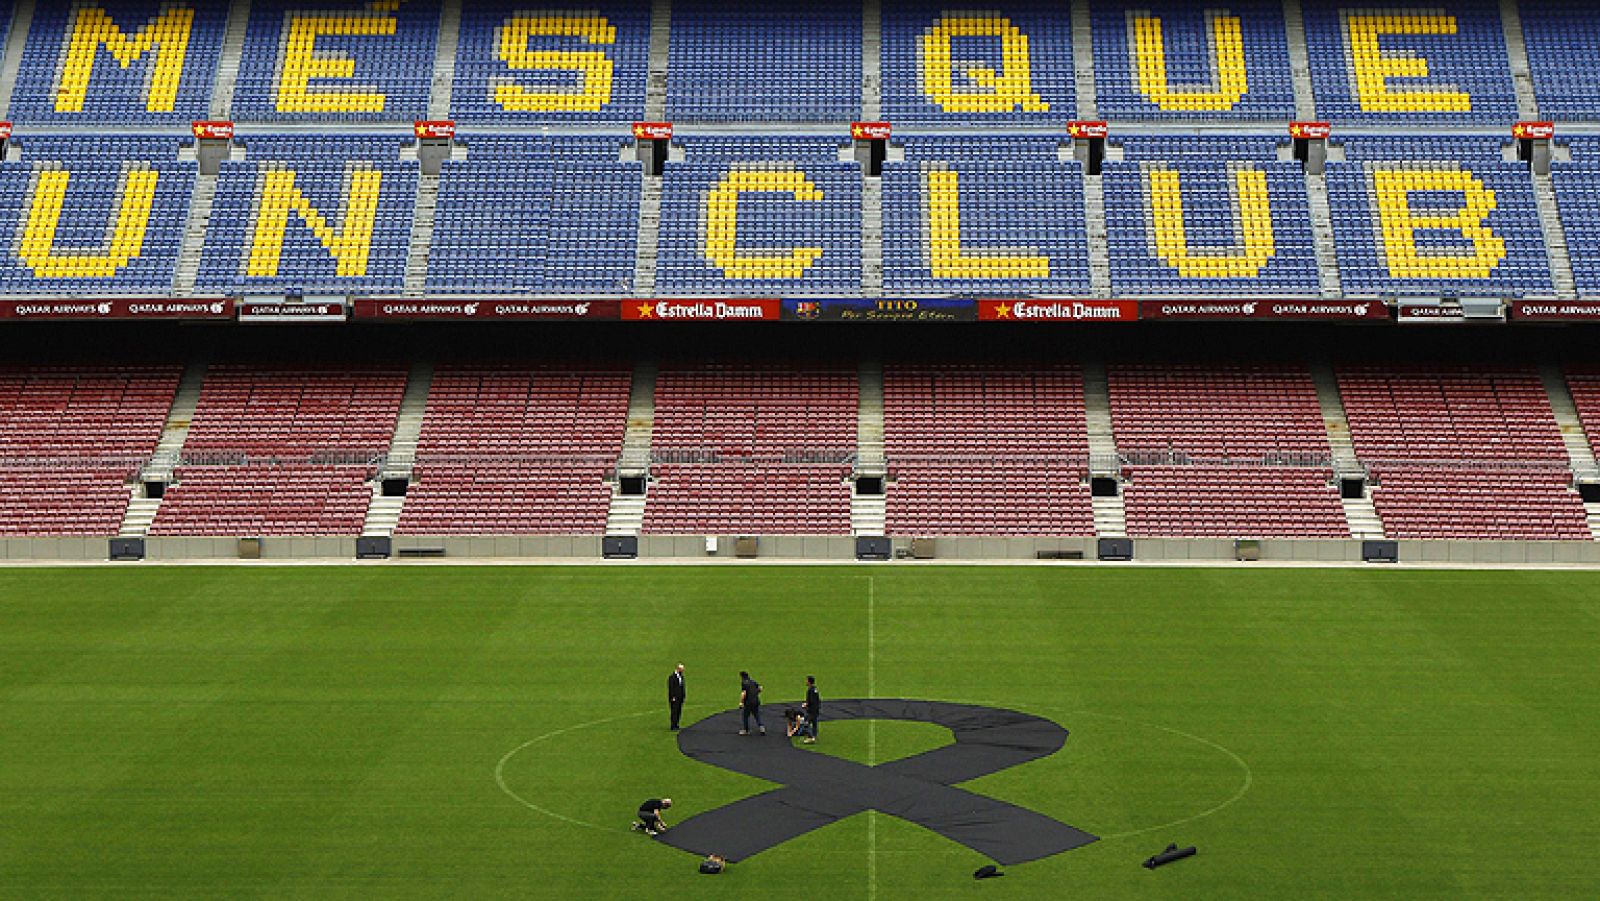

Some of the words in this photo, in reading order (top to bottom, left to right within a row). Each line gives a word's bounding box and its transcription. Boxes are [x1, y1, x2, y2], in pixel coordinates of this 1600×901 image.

[52, 0, 615, 112] MÉS
[920, 10, 1472, 112] QUE
[18, 166, 381, 278] UN
[705, 166, 1506, 279] CLUB
[16, 305, 50, 314] QATAR
[52, 305, 96, 313] AIRWAYS
[129, 304, 163, 313] QATAR
[166, 304, 208, 312] AIRWAYS
[383, 305, 417, 313] QATAR
[420, 305, 462, 313] AIRWAYS
[495, 305, 529, 313] QATAR
[531, 305, 573, 313] AIRWAYS
[655, 301, 713, 319] Estrella
[714, 302, 763, 318] Damm
[1013, 301, 1071, 318] Estrella
[1072, 302, 1121, 318] Damm
[1162, 305, 1195, 314] QATAR
[1197, 305, 1240, 313] AIRWAYS
[1272, 305, 1307, 314] QATAR
[1309, 305, 1353, 313] AIRWAYS
[1522, 305, 1557, 314] QATAR
